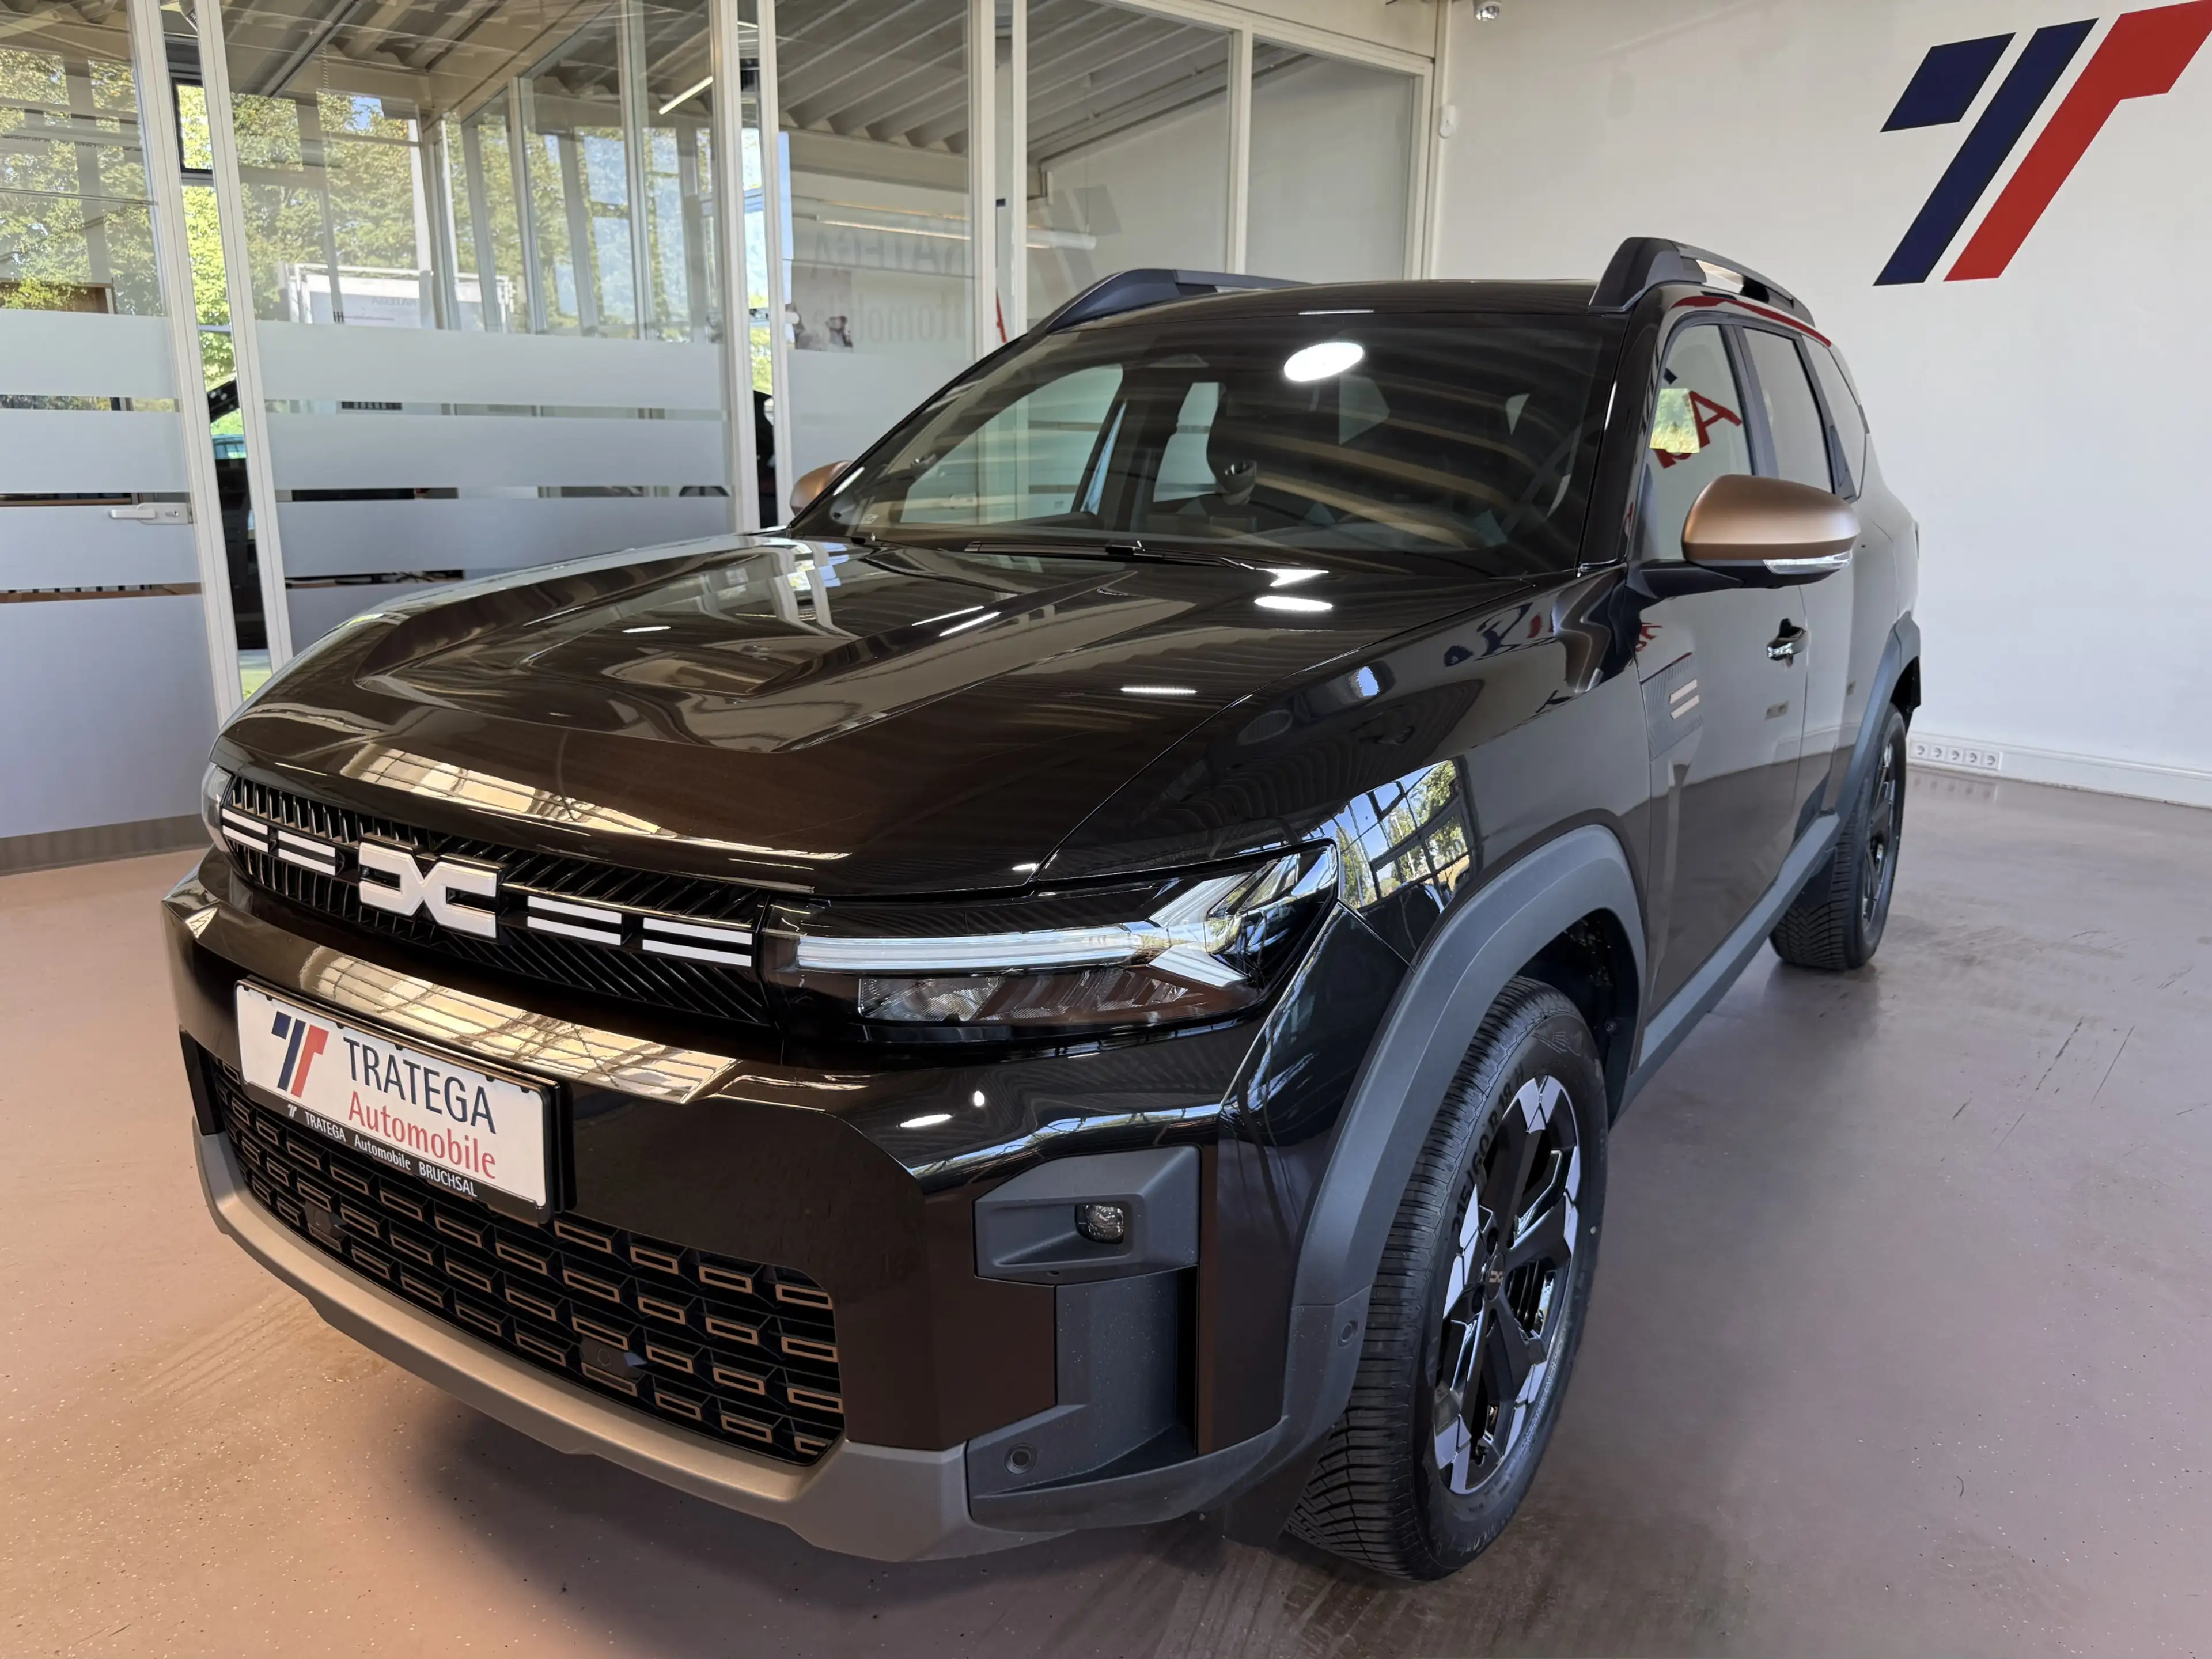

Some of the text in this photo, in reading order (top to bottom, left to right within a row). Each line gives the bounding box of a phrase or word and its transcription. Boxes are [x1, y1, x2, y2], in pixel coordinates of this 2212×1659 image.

[343, 1036, 497, 1134] TRATEGA
[304, 1110, 478, 1198] TRATEGA Automobile BRUCHSAL
[349, 1090, 496, 1179] Automobile
